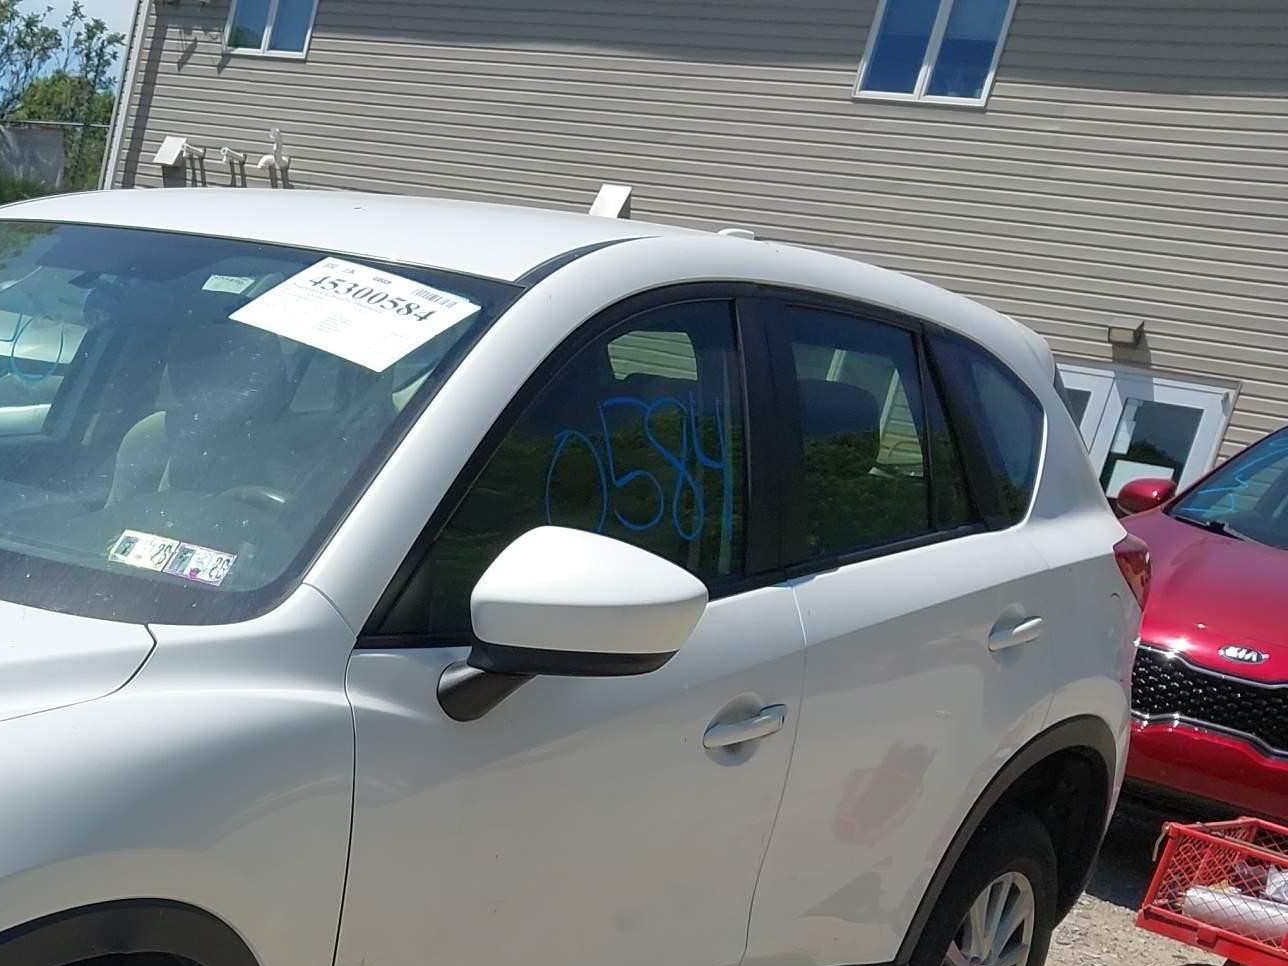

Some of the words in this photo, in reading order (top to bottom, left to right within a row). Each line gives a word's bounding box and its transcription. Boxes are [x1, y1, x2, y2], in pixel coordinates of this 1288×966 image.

[309, 275, 437, 322] 45300584
[545, 391, 734, 543] 0584
[1225, 646, 1258, 662] KIA
